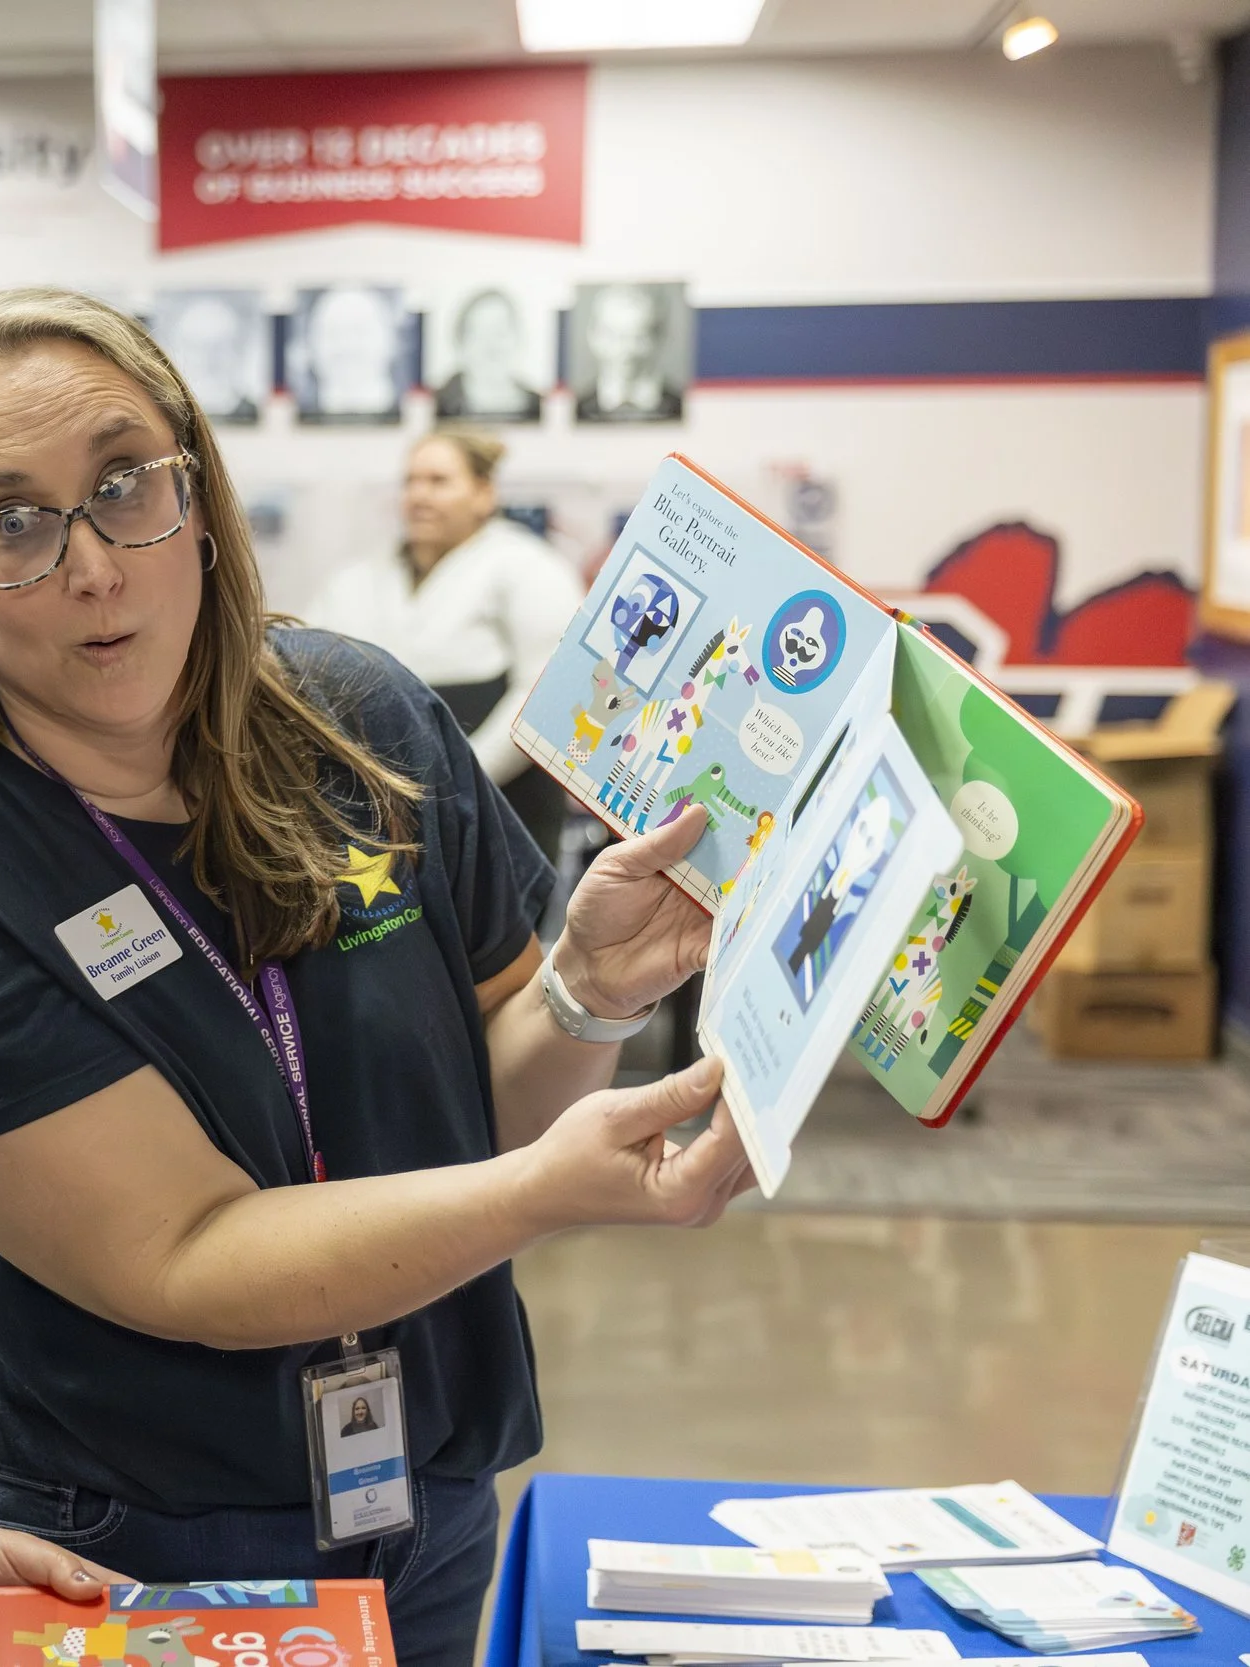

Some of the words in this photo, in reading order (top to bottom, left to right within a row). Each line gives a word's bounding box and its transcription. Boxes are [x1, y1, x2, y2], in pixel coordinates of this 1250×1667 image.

[197, 128, 306, 171] OVER
[356, 121, 546, 167] DECADES
[194, 171, 241, 204] OF
[244, 169, 395, 203] BUSINESS
[397, 165, 545, 200] SUCCESS
[653, 493, 684, 526] Blue
[685, 517, 738, 567] Portrait
[671, 484, 691, 505] Let's
[692, 502, 724, 528] explore
[724, 523, 739, 540] the
[658, 525, 707, 574] Gallery.
[745, 722, 758, 734] do
[758, 731, 775, 750] you
[775, 743, 793, 761] like
[754, 708, 782, 735] Which
[782, 732, 799, 749] one
[750, 741, 775, 763] best?
[960, 808, 1002, 843] thinking?
[977, 801, 986, 812] Is
[986, 808, 999, 824] he
[86, 947, 133, 979] Breanne
[131, 928, 167, 952] Green
[337, 916, 405, 952] Livingston
[111, 965, 137, 983] Family
[134, 951, 161, 969] Liaison
[266, 966, 287, 1010] Agency
[276, 1012, 302, 1083] SERVICE
[358, 1595, 378, 1653] introducing
